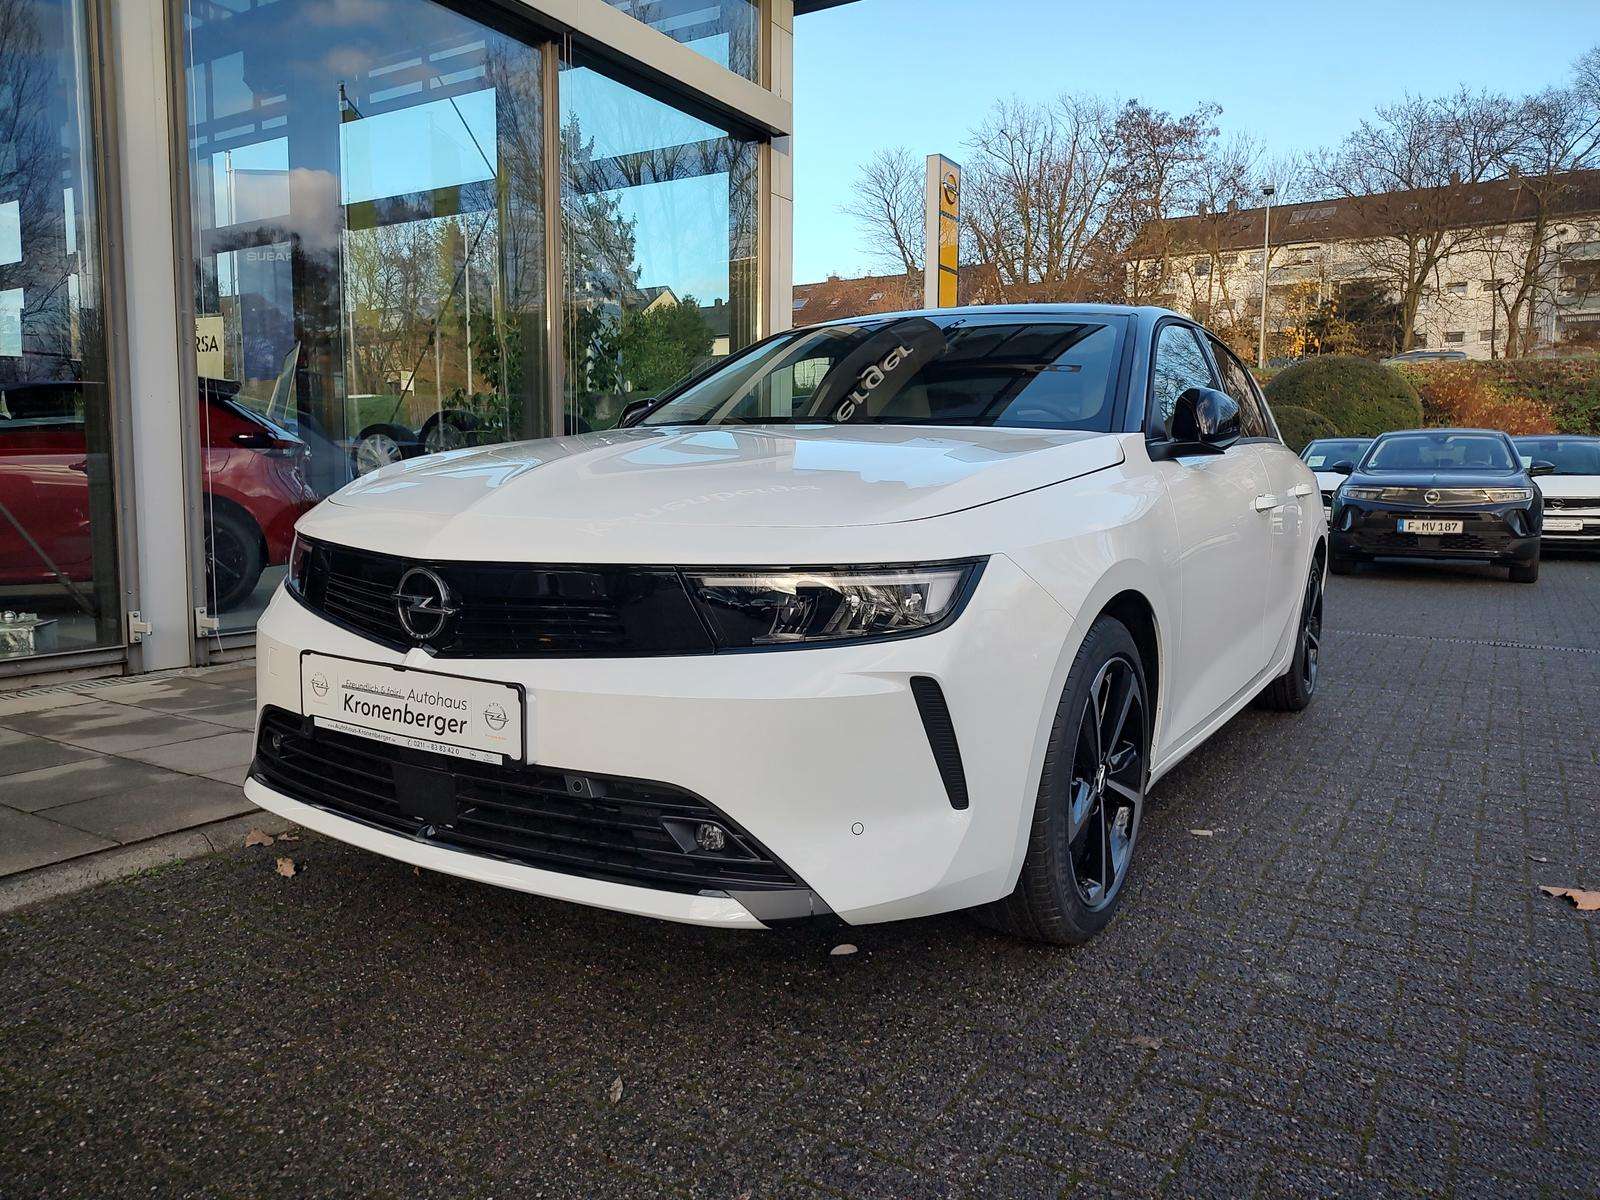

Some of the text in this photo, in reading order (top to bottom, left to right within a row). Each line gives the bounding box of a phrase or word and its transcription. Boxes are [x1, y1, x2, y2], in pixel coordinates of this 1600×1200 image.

[1438, 522, 1458, 532] 187
[406, 688, 468, 711] Autohaus
[343, 693, 468, 736] Kronenberger
